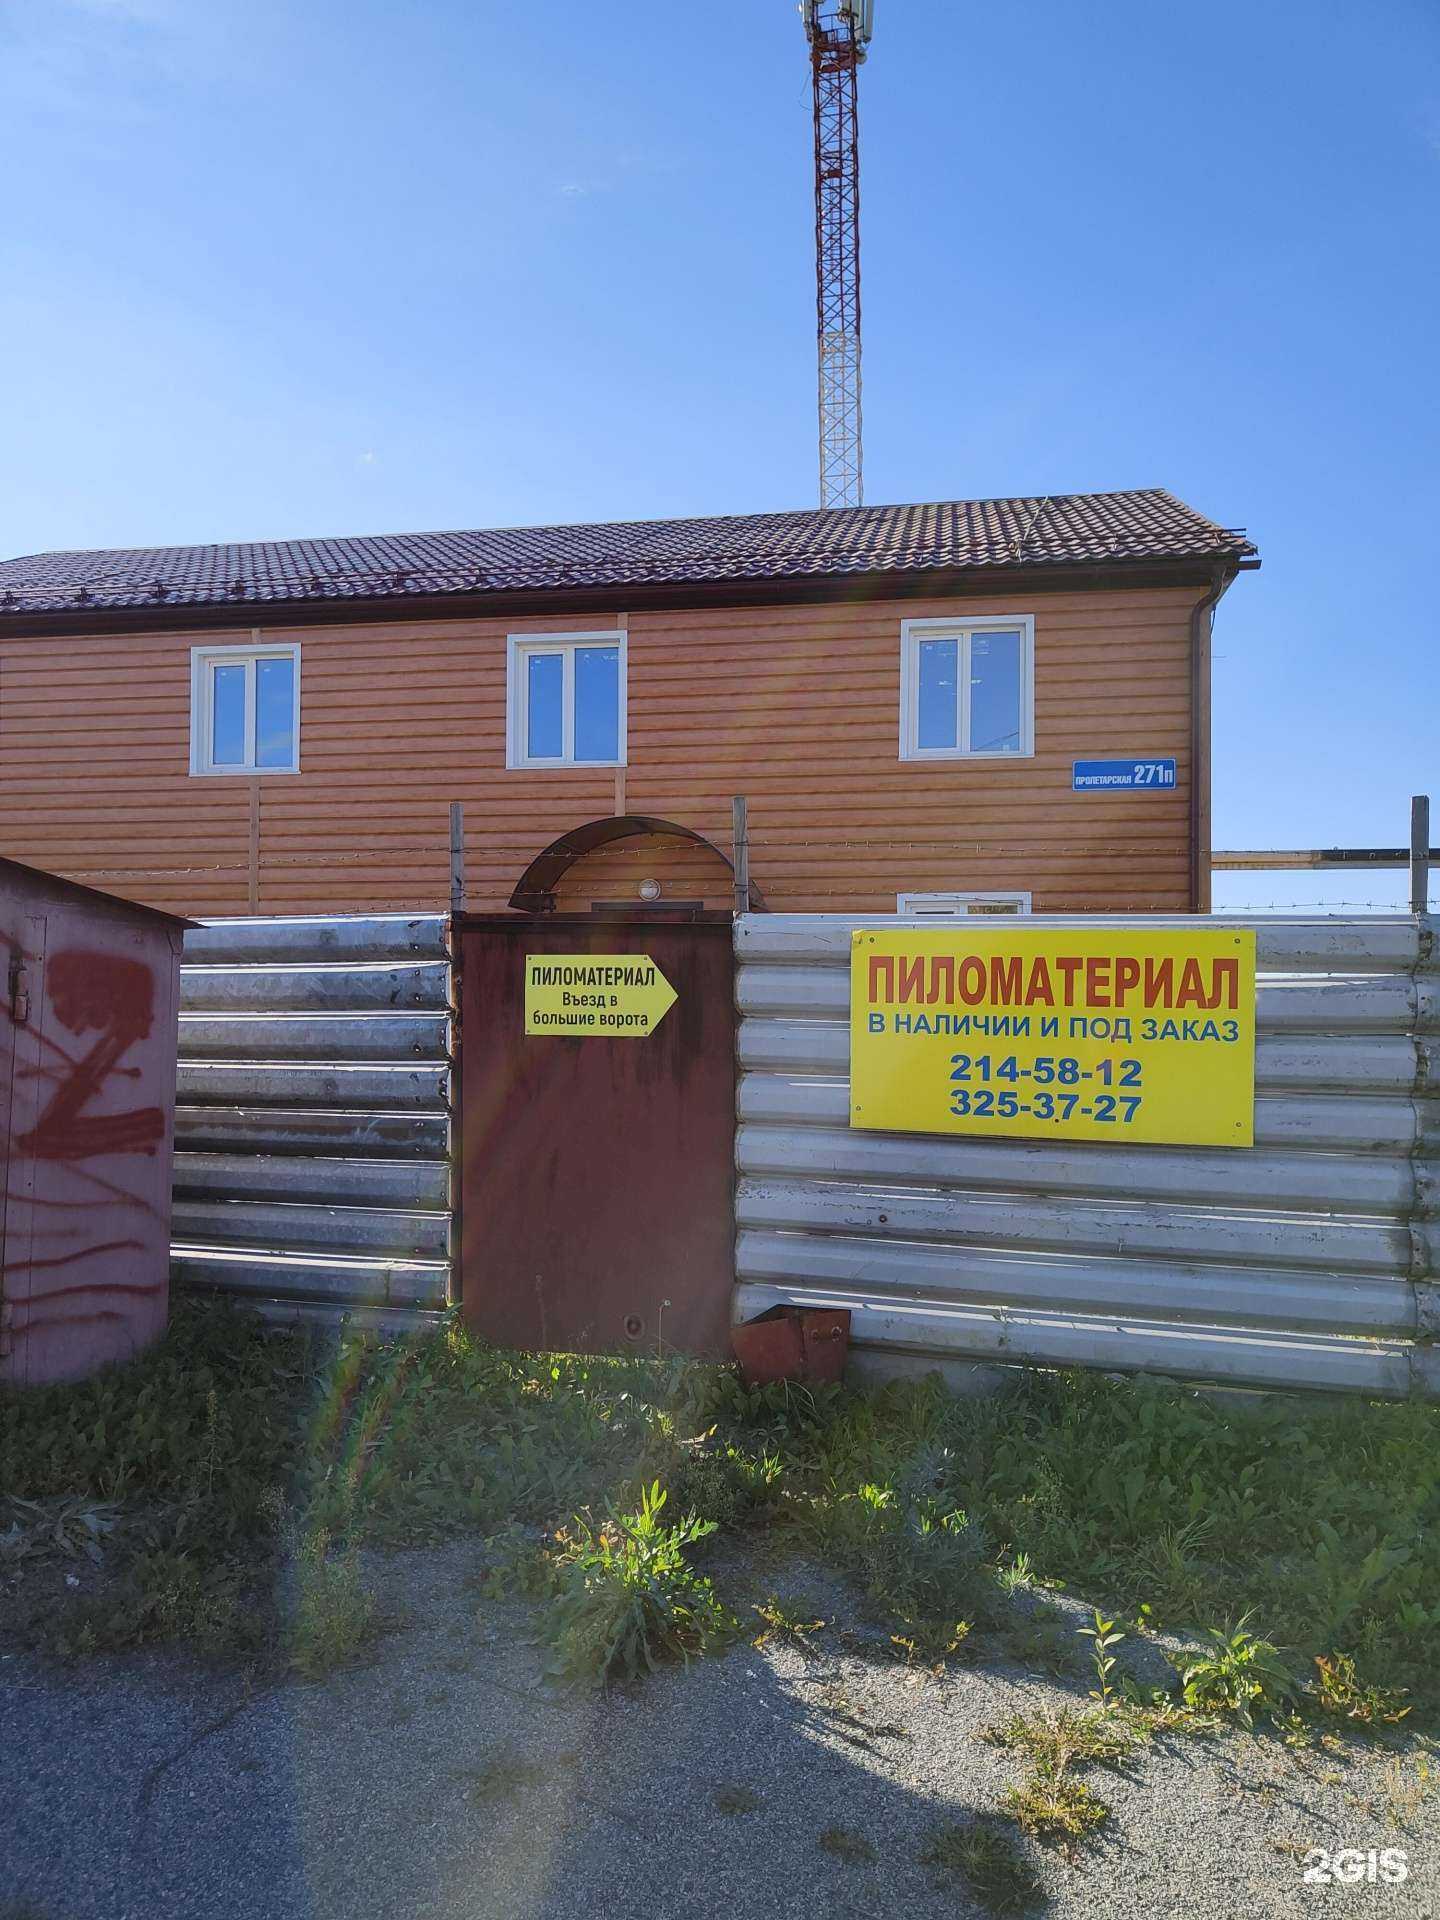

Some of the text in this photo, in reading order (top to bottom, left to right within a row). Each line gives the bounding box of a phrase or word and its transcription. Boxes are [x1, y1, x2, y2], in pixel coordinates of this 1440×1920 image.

[1075, 775, 1132, 785] ПРОЛЕТАРСКАЯ
[531, 966, 655, 986] ПИЛОМАТЕРИАЛ
[868, 955, 1239, 1009] ПИЛОМАТЕРИАЛ
[562, 991, 618, 1007] Въезд в
[533, 1010, 648, 1028] большие ворота
[868, 1013, 1239, 1044] В НАЛИЧИИ И ПОД ЗАКАЗ
[949, 1054, 1142, 1087] 214-58-12
[949, 1089, 1142, 1123] 325-37-27
